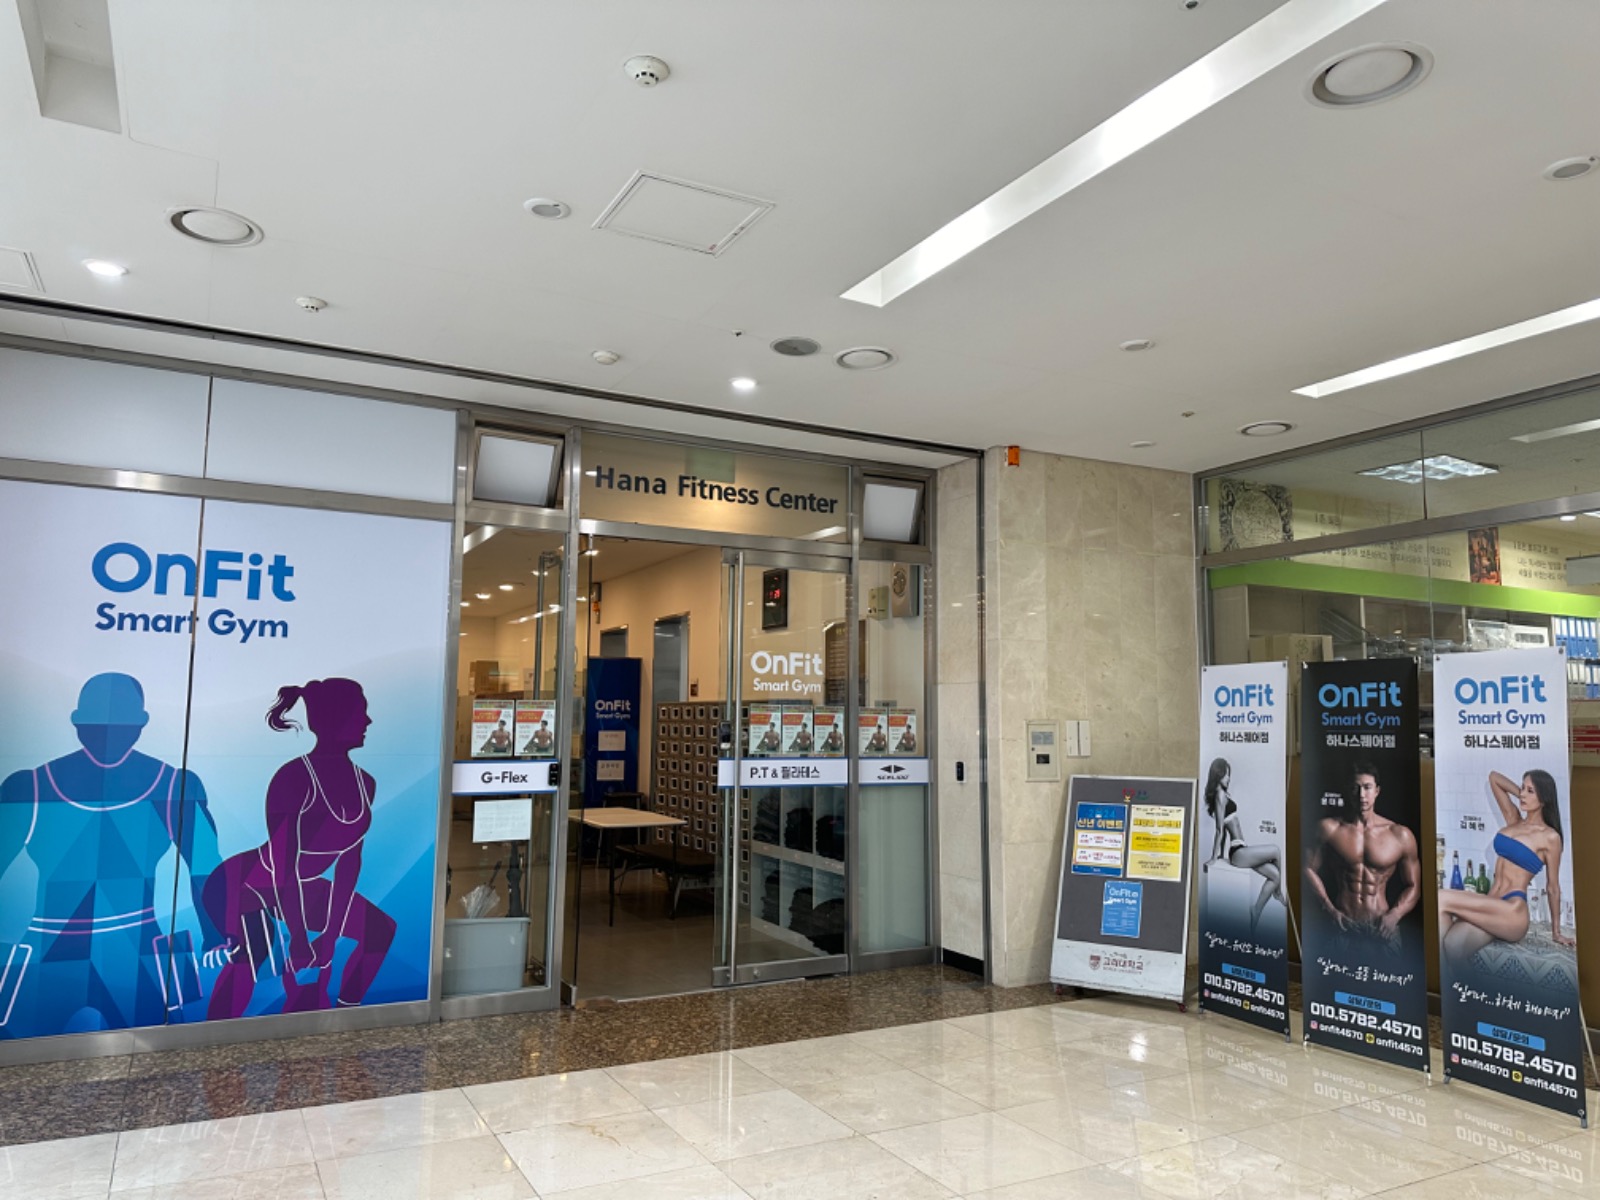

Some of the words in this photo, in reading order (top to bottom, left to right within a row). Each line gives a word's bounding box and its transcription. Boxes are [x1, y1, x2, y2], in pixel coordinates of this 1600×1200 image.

[595, 466, 666, 494] Hana
[678, 475, 759, 505] Fitness
[766, 487, 838, 514] Center
[92, 542, 296, 602] OnFit
[95, 602, 199, 635] Smart
[208, 609, 288, 643] Gym
[750, 650, 823, 676] OnFit
[753, 678, 789, 692] Smart
[792, 678, 821, 695] Gym
[1214, 683, 1275, 708] OnFit
[1318, 681, 1402, 708] OnFit
[1454, 674, 1548, 705] OnFit
[594, 699, 631, 711] OnFit
[1216, 711, 1245, 724] Smart
[1247, 711, 1273, 726] Gym
[1321, 712, 1361, 726] Smart
[1364, 712, 1400, 729] Gym
[1458, 709, 1502, 725] Smart
[1505, 709, 1546, 729] Gym
[1219, 731, 1269, 743] 하나스퀘어점
[1326, 734, 1396, 748] 하나스퀘어점
[1464, 734, 1540, 750] 하나스퀘어점
[481, 771, 528, 784] G-Flex
[750, 766, 768, 779] P.T
[771, 768, 778, 778] &
[781, 766, 820, 780] 필라테스
[1077, 817, 1095, 828] 신년
[1204, 972, 1285, 1006] 010.5782.4570
[1310, 1001, 1422, 1040] 010.5782.4570
[1319, 1023, 1364, 1041] onfit4570
[1376, 1037, 1423, 1056] onfit4570
[1491, 1027, 1530, 1045] 상담/문의
[1451, 1033, 1577, 1081] 010.5782.4570
[1461, 1057, 1510, 1078] onfit4570
[1524, 1076, 1578, 1099] onfit4570
